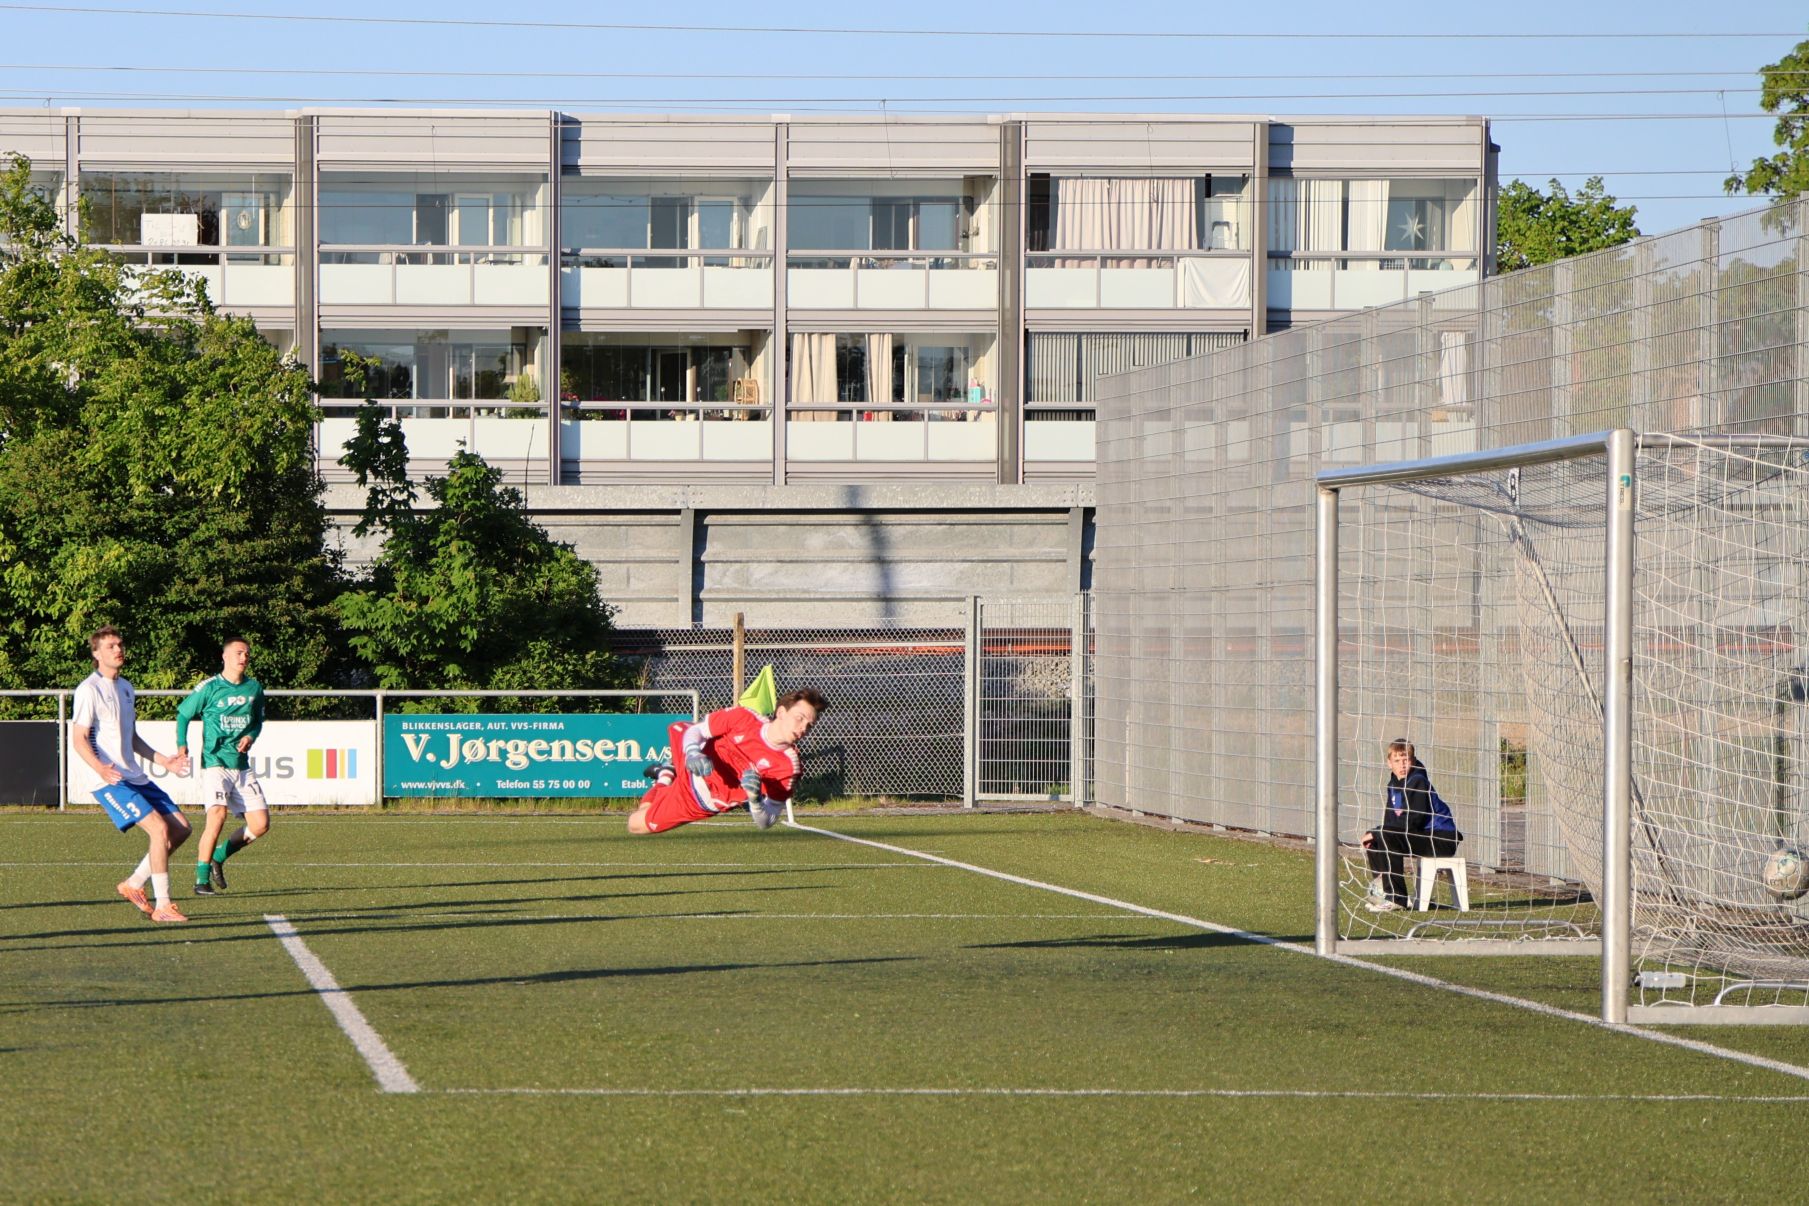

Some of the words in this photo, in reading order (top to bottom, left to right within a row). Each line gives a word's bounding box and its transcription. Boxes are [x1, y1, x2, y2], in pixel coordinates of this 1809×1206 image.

[402, 721, 484, 731] BLIKKENSLAGER,
[487, 721, 508, 731] AUT.
[511, 721, 565, 731] VVS-FIRMA
[400, 733, 436, 763] V.
[439, 733, 643, 771] Jørgensen
[645, 745, 673, 763] A/S
[495, 779, 530, 790] Telefon
[532, 780, 545, 790] 55
[548, 780, 560, 790] 75
[562, 780, 576, 790] 00
[577, 780, 591, 790] 00
[621, 779, 648, 790] Etabl.
[126, 802, 141, 818] 3
